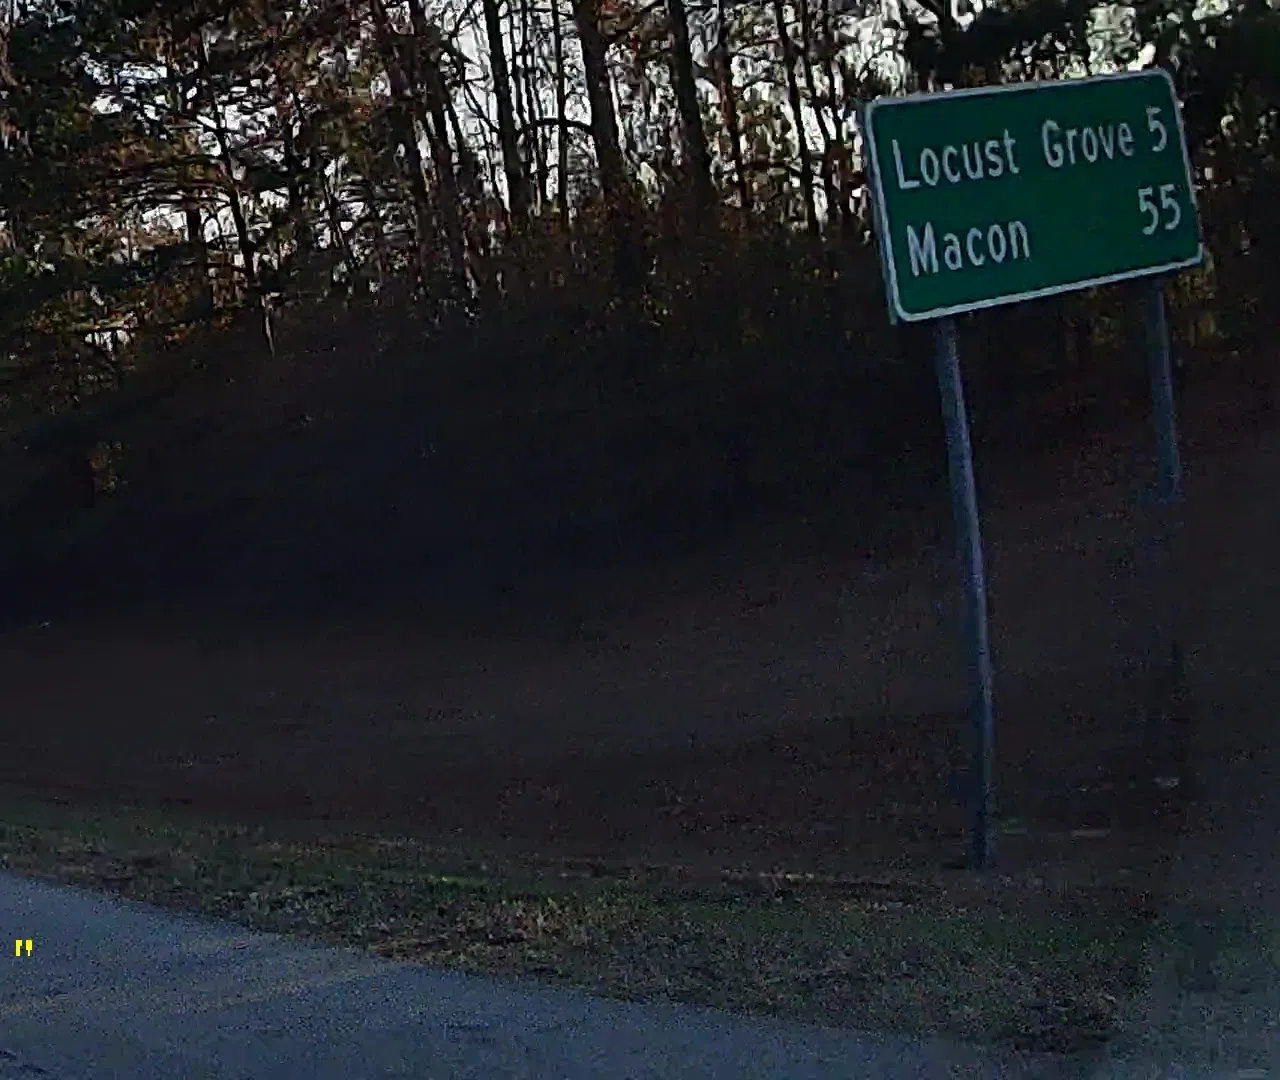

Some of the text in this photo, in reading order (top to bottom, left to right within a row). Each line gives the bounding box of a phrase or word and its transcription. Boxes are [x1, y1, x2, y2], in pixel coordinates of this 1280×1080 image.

[892, 104, 1169, 190] Locust Grove 5
[906, 183, 1182, 277] Macon 55
